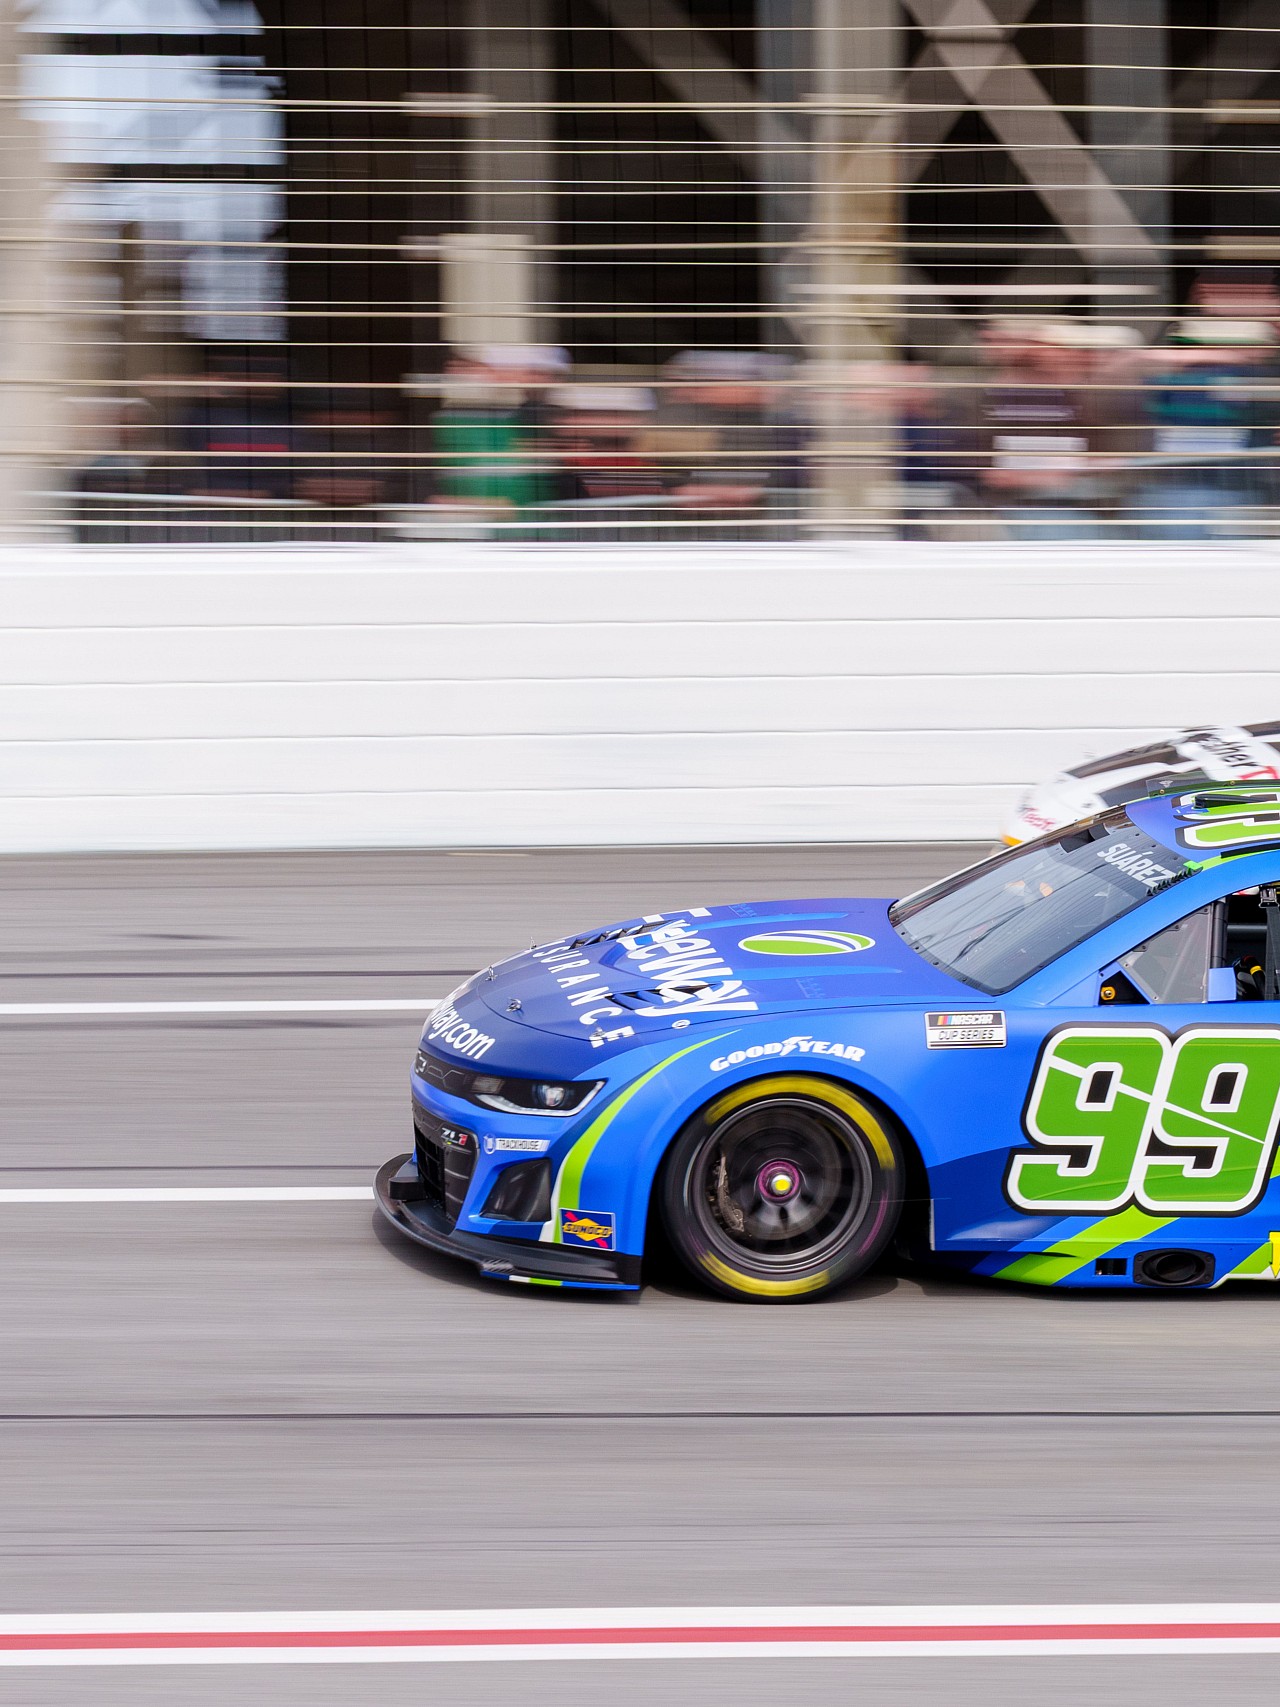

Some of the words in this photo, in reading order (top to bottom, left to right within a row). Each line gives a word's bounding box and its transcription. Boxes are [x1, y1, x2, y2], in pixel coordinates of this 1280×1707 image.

[1097, 843, 1177, 888] SUÁREZ
[524, 940, 635, 1048] SURANCE
[951, 1014, 994, 1025] NASCAR
[939, 1030, 958, 1040] CUP
[960, 1029, 994, 1040] SERIES
[709, 1036, 865, 1071] GOODYEAR
[498, 1138, 540, 1151] TRACKHOUSE
